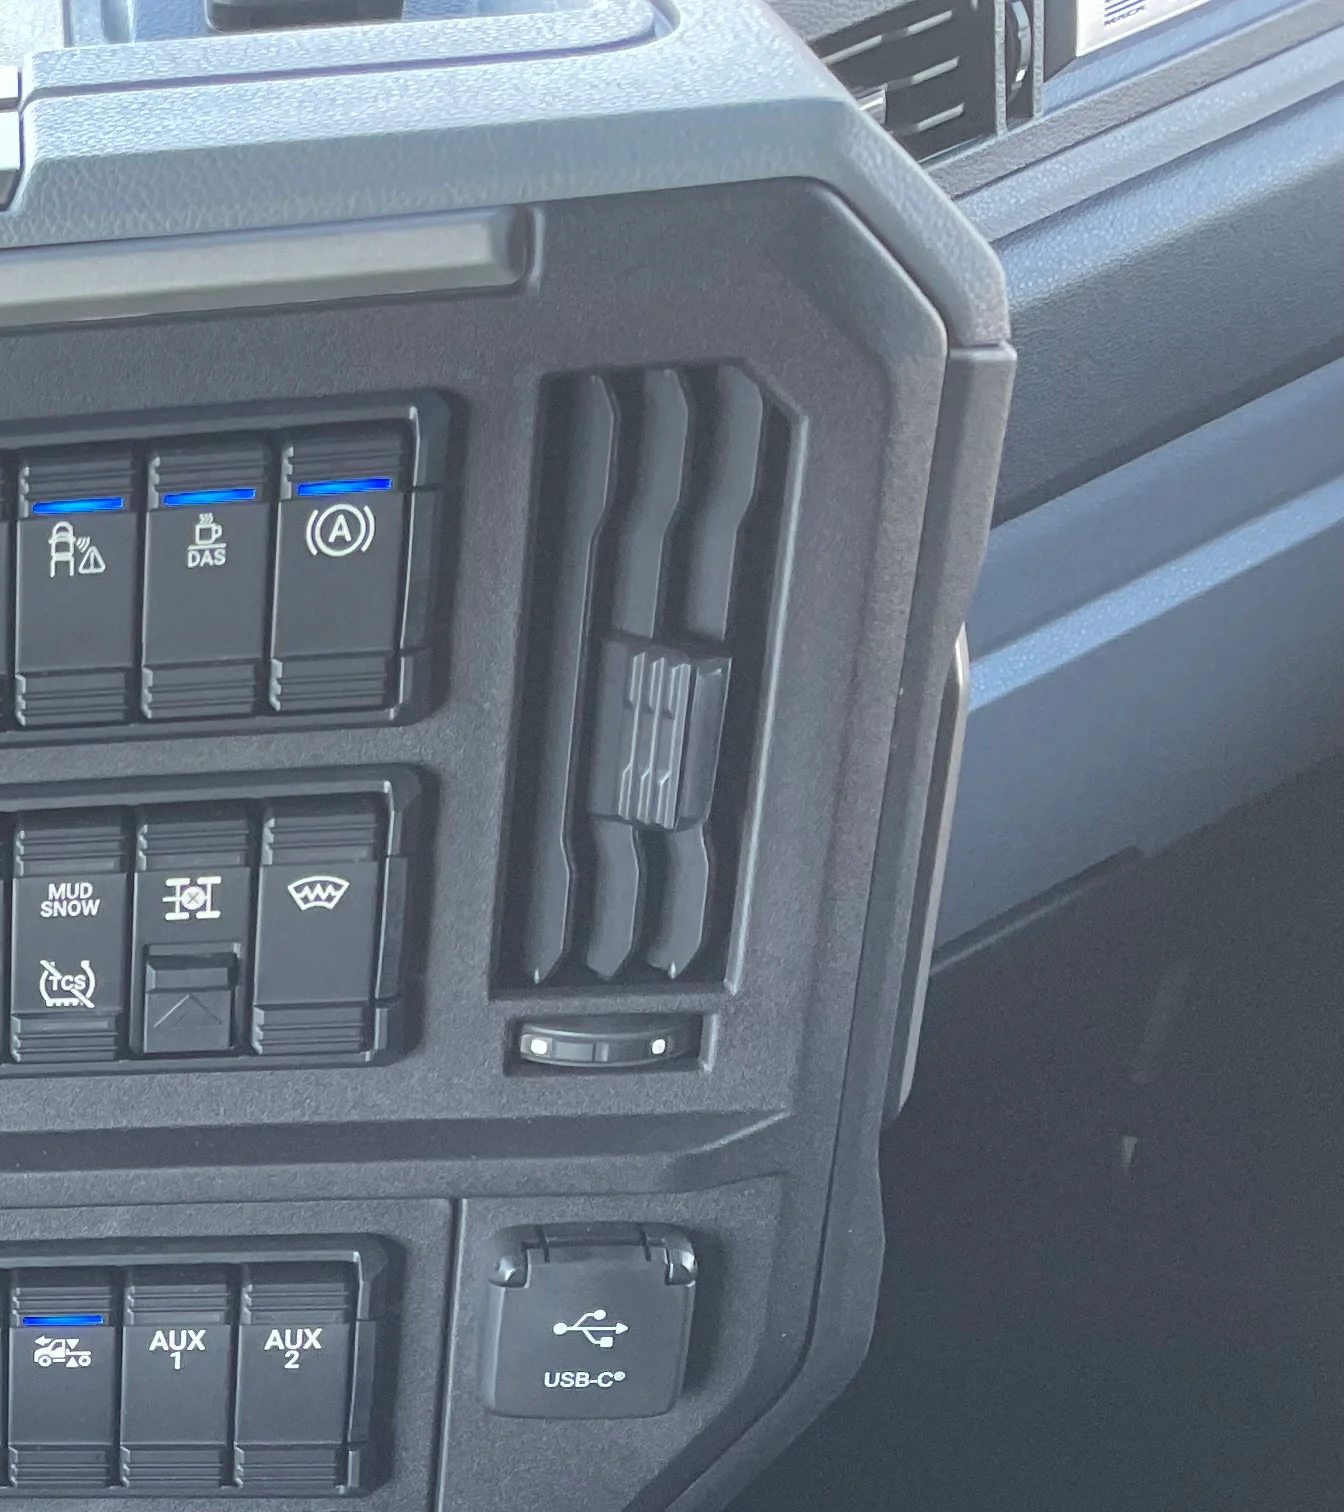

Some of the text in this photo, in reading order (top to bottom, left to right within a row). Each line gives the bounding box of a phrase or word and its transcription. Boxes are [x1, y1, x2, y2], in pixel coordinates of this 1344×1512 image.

[187, 549, 226, 568] DAS
[48, 882, 94, 900] MUD
[40, 899, 100, 918] SNOW
[50, 974, 86, 993] TCS
[149, 1329, 206, 1352] AUX
[264, 1328, 322, 1351] AUX
[170, 1351, 182, 1371] 1
[284, 1350, 300, 1369] 2
